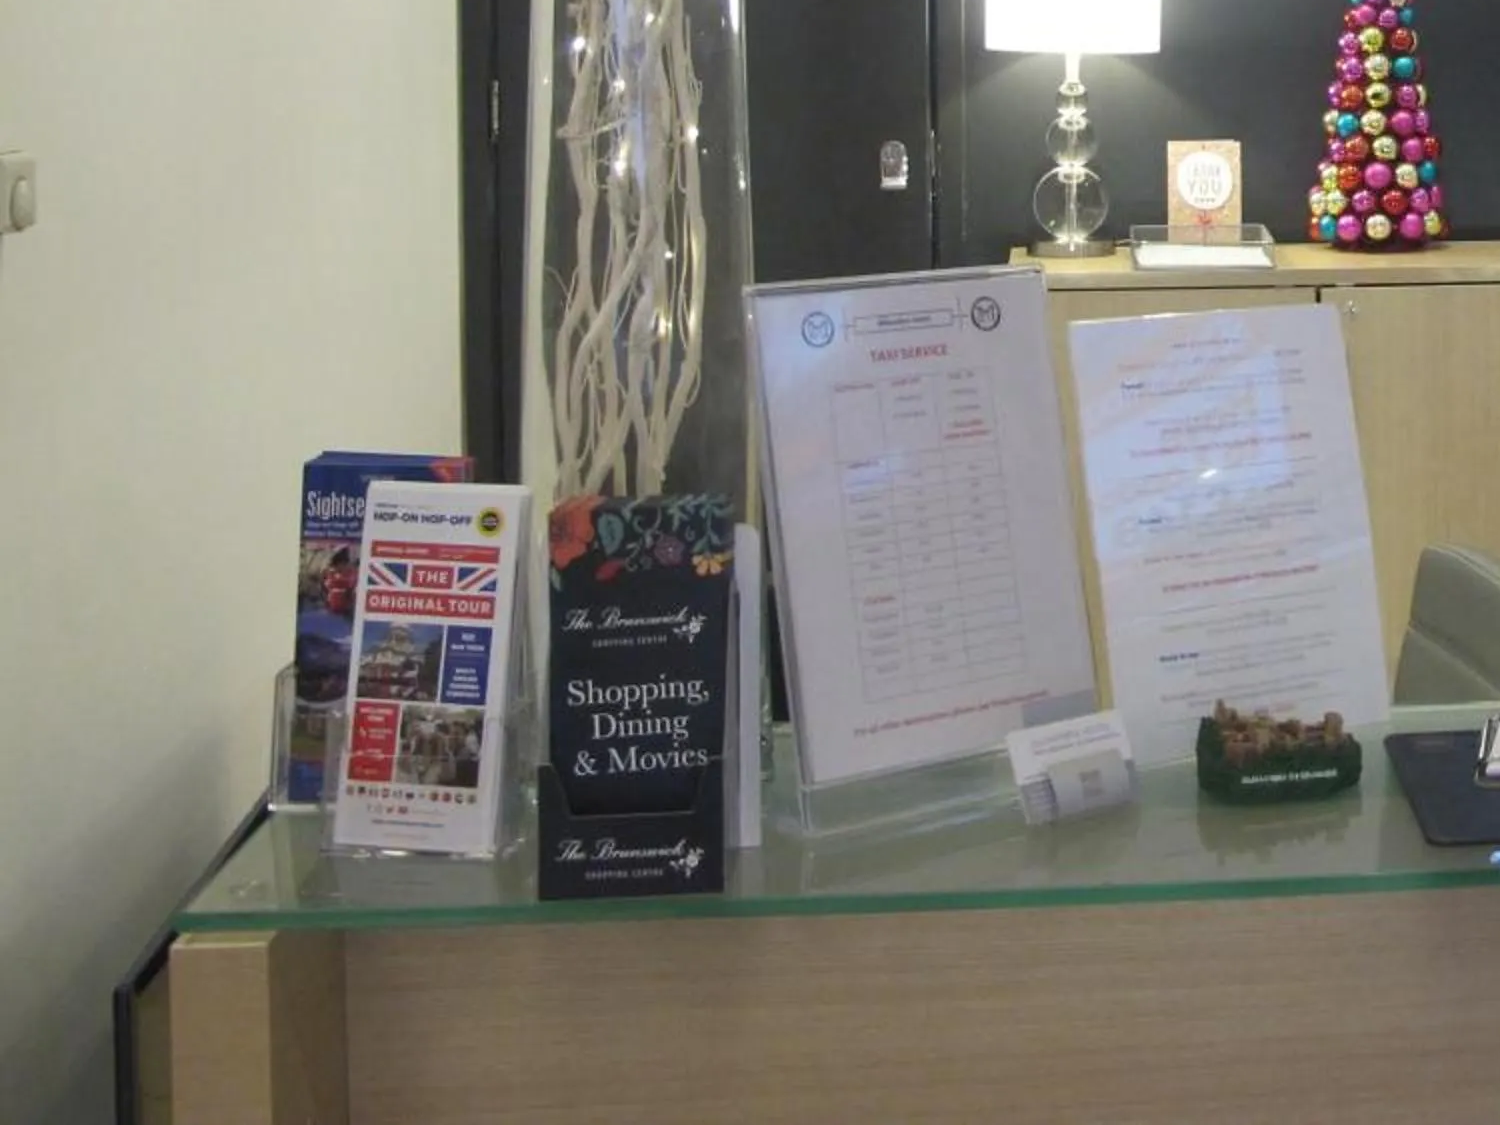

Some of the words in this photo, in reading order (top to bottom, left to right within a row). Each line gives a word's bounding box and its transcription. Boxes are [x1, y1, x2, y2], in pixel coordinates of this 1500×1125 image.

[900, 343, 950, 361] SERVICE
[373, 512, 419, 524] HOP-ON
[421, 514, 473, 526] HOP-OFF
[415, 570, 449, 585] THE
[368, 594, 447, 613] ORIGINAL
[448, 598, 492, 615] TOUR
[562, 607, 593, 632] The
[597, 605, 689, 630] Brunswick
[566, 673, 710, 711] Shopping,
[591, 709, 690, 740] Dining
[573, 750, 598, 776] &
[606, 742, 709, 775] Movies
[554, 838, 587, 863] The
[589, 837, 687, 861] Brunswick
